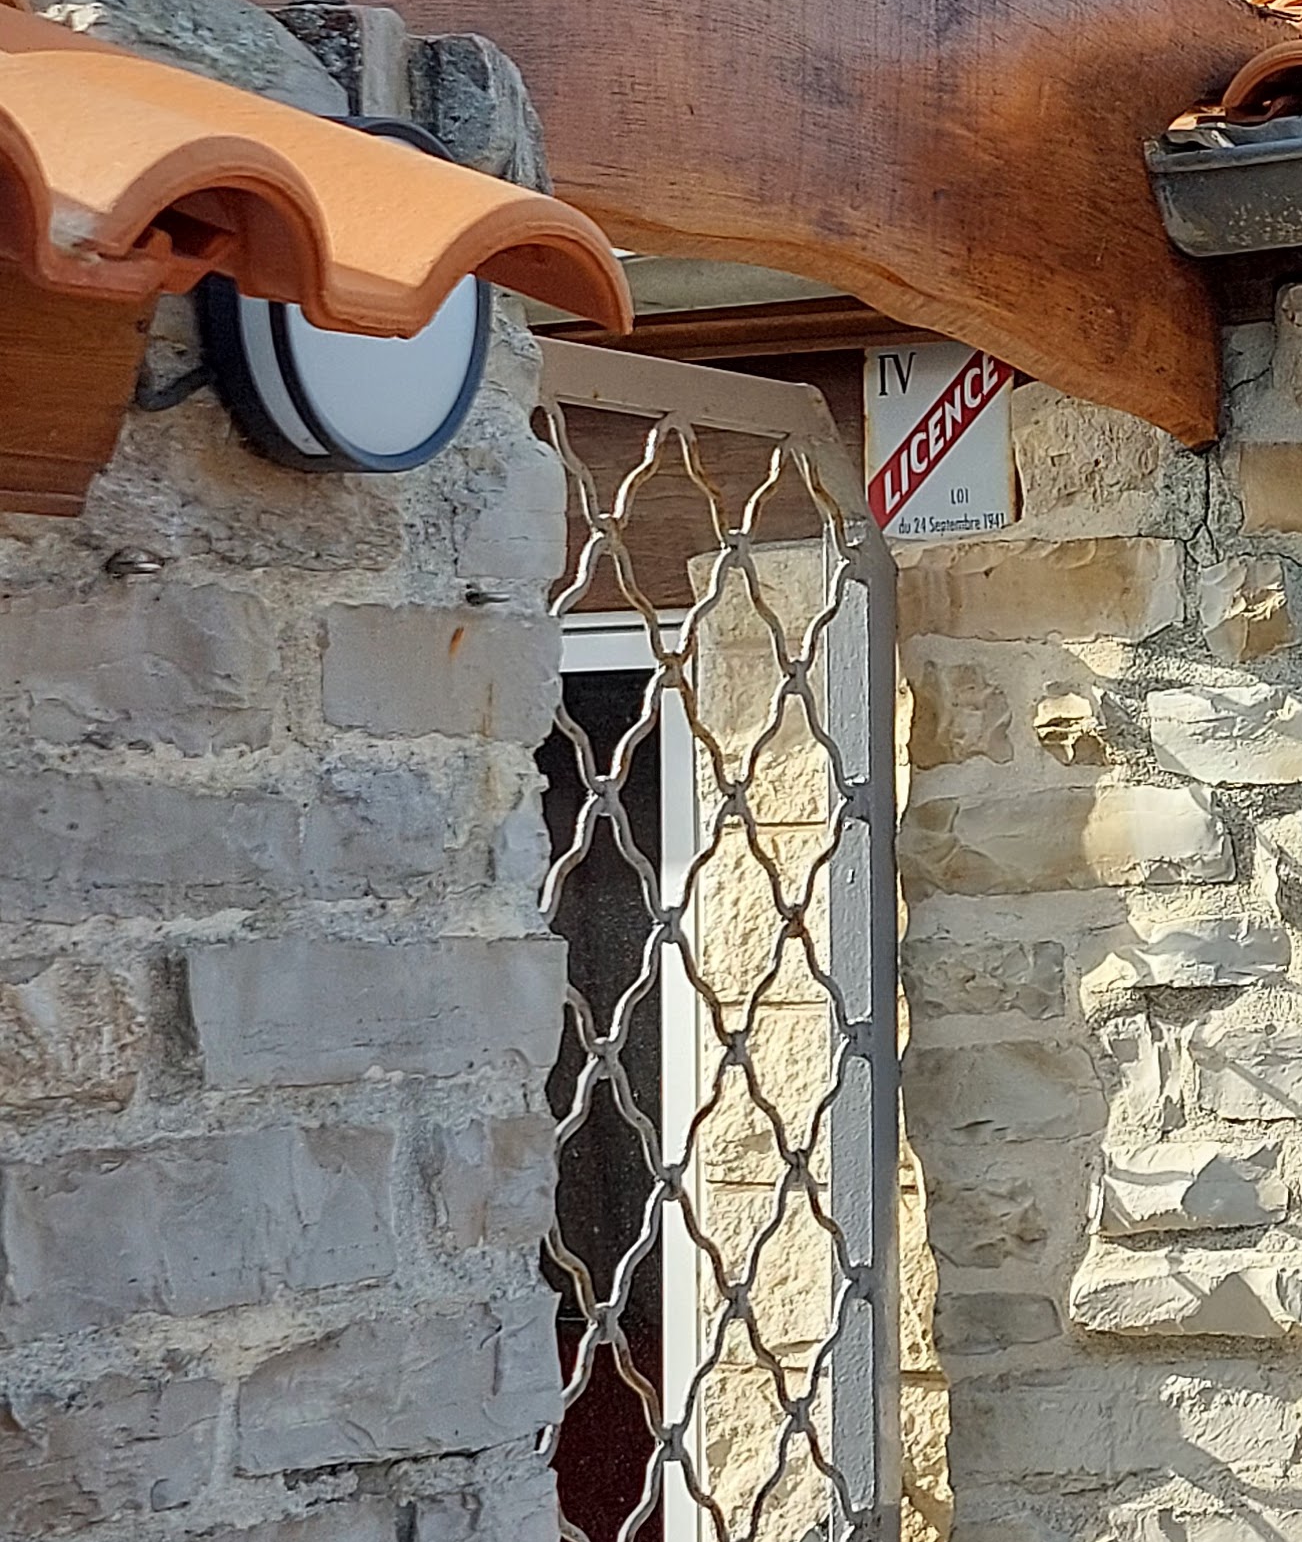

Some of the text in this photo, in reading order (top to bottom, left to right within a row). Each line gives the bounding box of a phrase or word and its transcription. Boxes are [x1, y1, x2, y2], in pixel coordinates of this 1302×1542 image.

[877, 352, 917, 397] IV
[883, 352, 999, 515] LICENCE
[950, 487, 969, 505] LOI
[898, 512, 1005, 537] du 24 Septembre 1941
